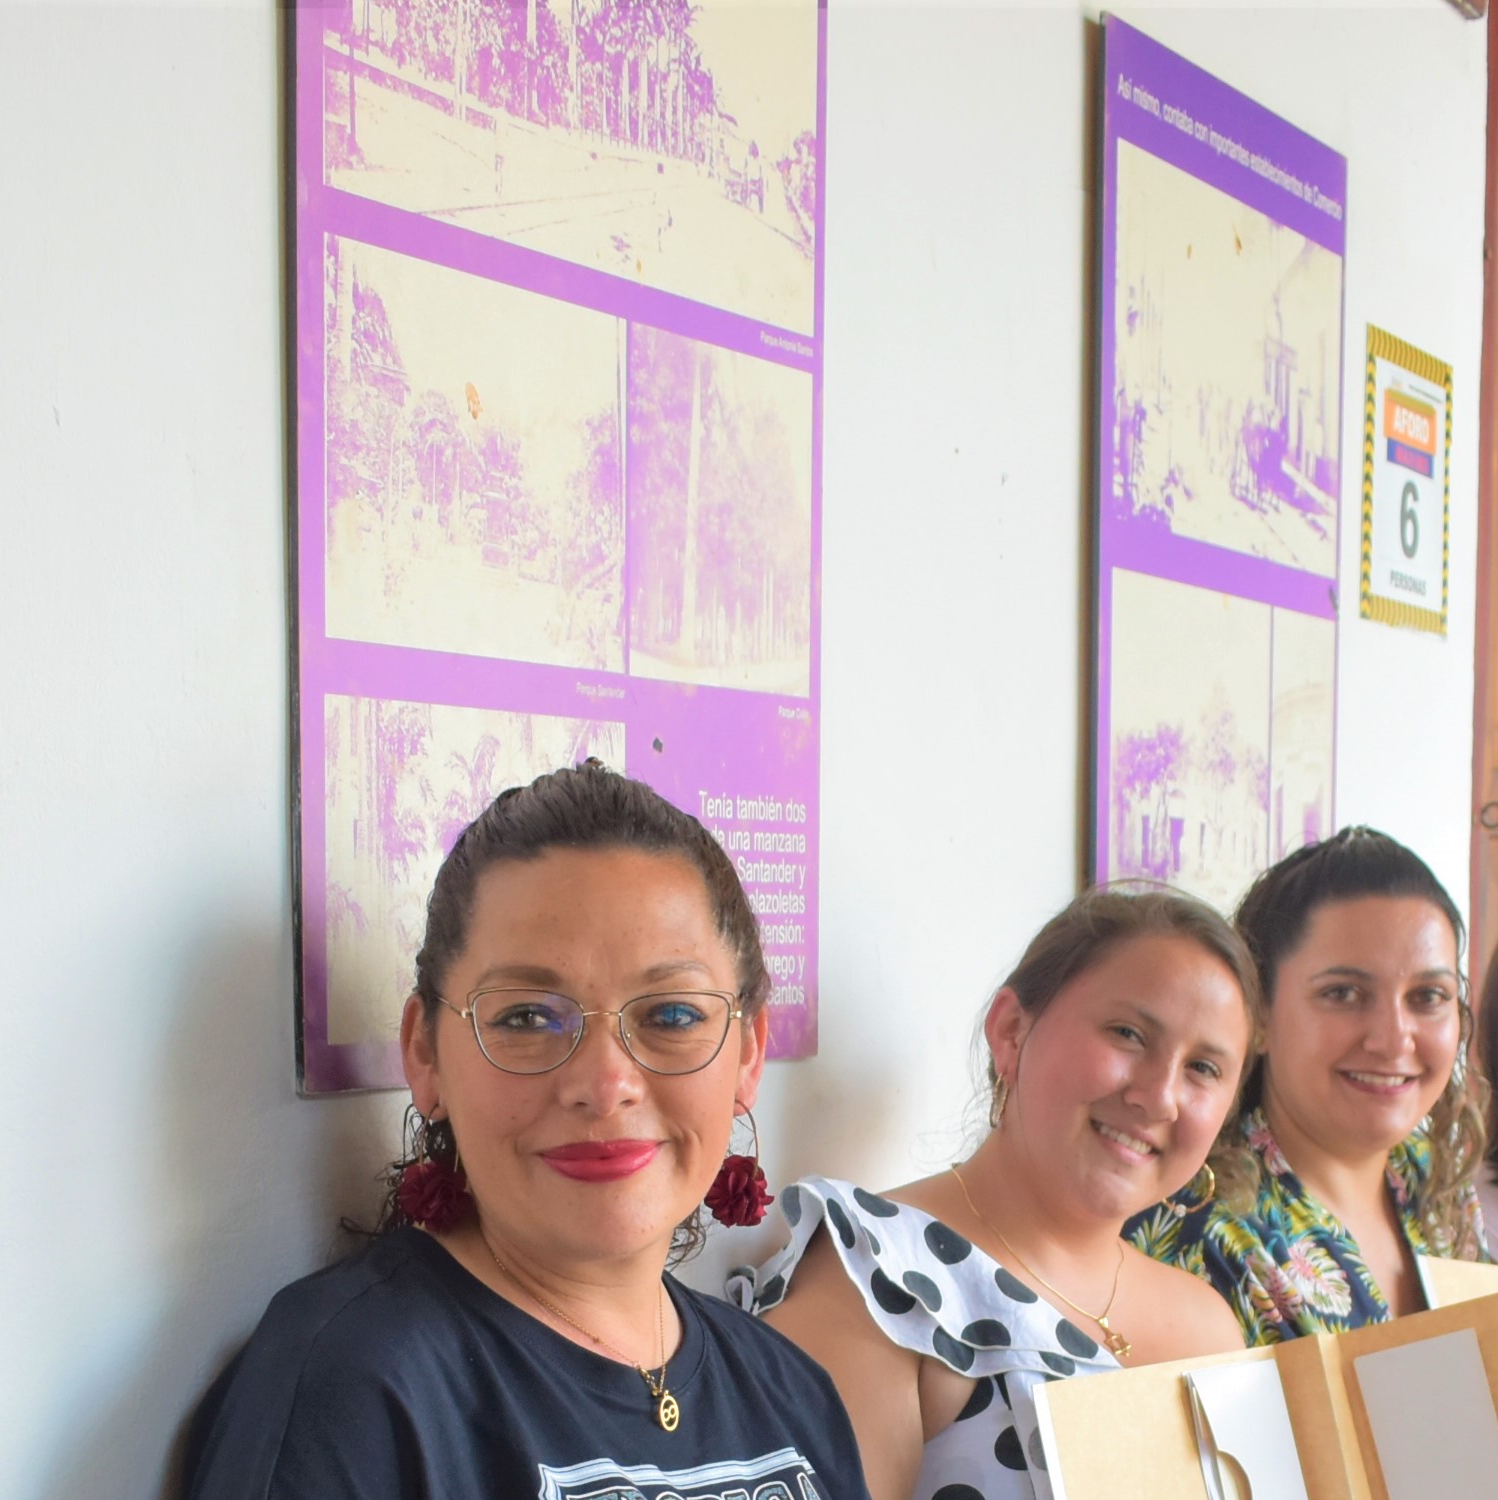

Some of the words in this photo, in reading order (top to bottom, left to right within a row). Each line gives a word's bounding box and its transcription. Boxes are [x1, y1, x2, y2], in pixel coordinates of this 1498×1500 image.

[1133, 84, 1162, 119] mismo,
[1163, 103, 1194, 135] contaba
[1195, 121, 1209, 142] con
[1393, 404, 1430, 445] AFORO
[1400, 478, 1419, 559] 6
[1389, 570, 1427, 598] PERSONAS
[698, 790, 733, 819] Tenía
[737, 794, 782, 820] también
[785, 798, 806, 823] dos
[729, 831, 751, 851] una
[754, 832, 806, 853] manzana
[737, 856, 796, 883] Santander
[799, 865, 806, 890] y
[759, 919, 805, 944] tensión:
[763, 950, 795, 980] brego
[798, 954, 806, 980] y
